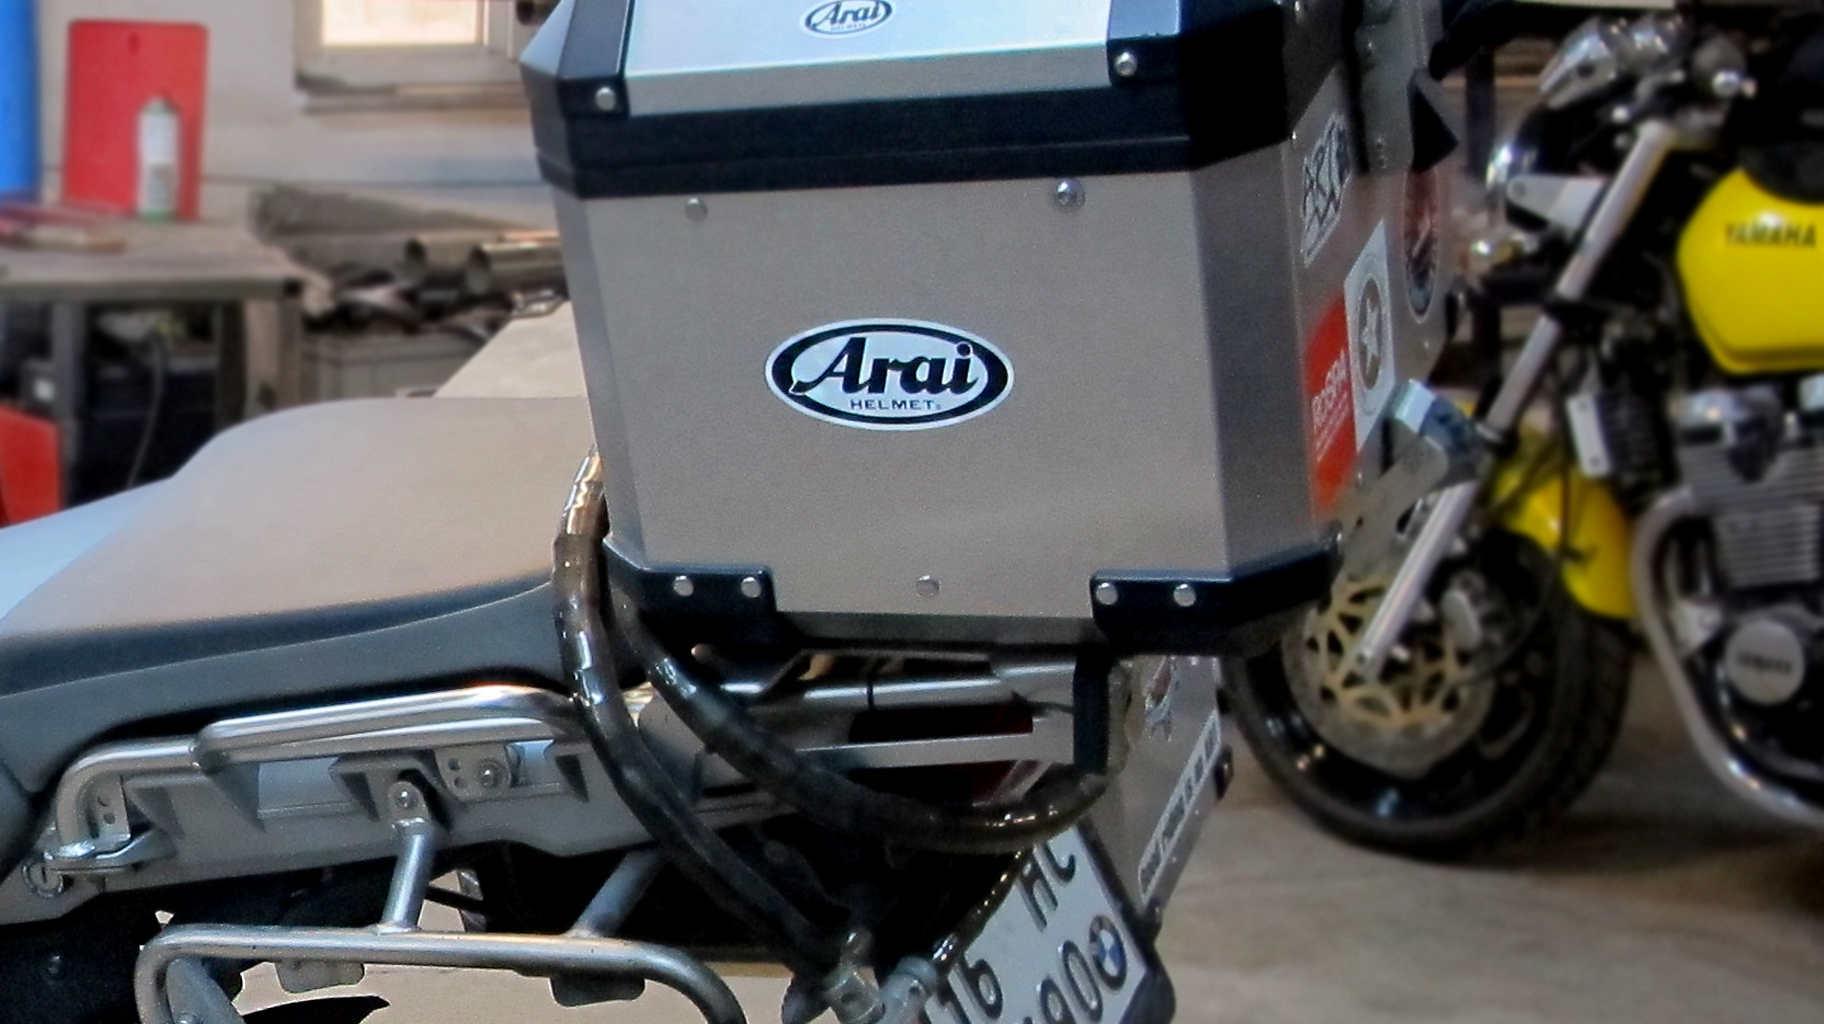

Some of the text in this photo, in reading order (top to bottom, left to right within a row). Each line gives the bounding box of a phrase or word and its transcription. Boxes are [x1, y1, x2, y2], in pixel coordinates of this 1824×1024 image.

[811, 0, 879, 28] Arai
[1725, 222, 1816, 247] YAMAHA
[790, 337, 978, 394] Arai
[850, 399, 934, 410] HELMET
